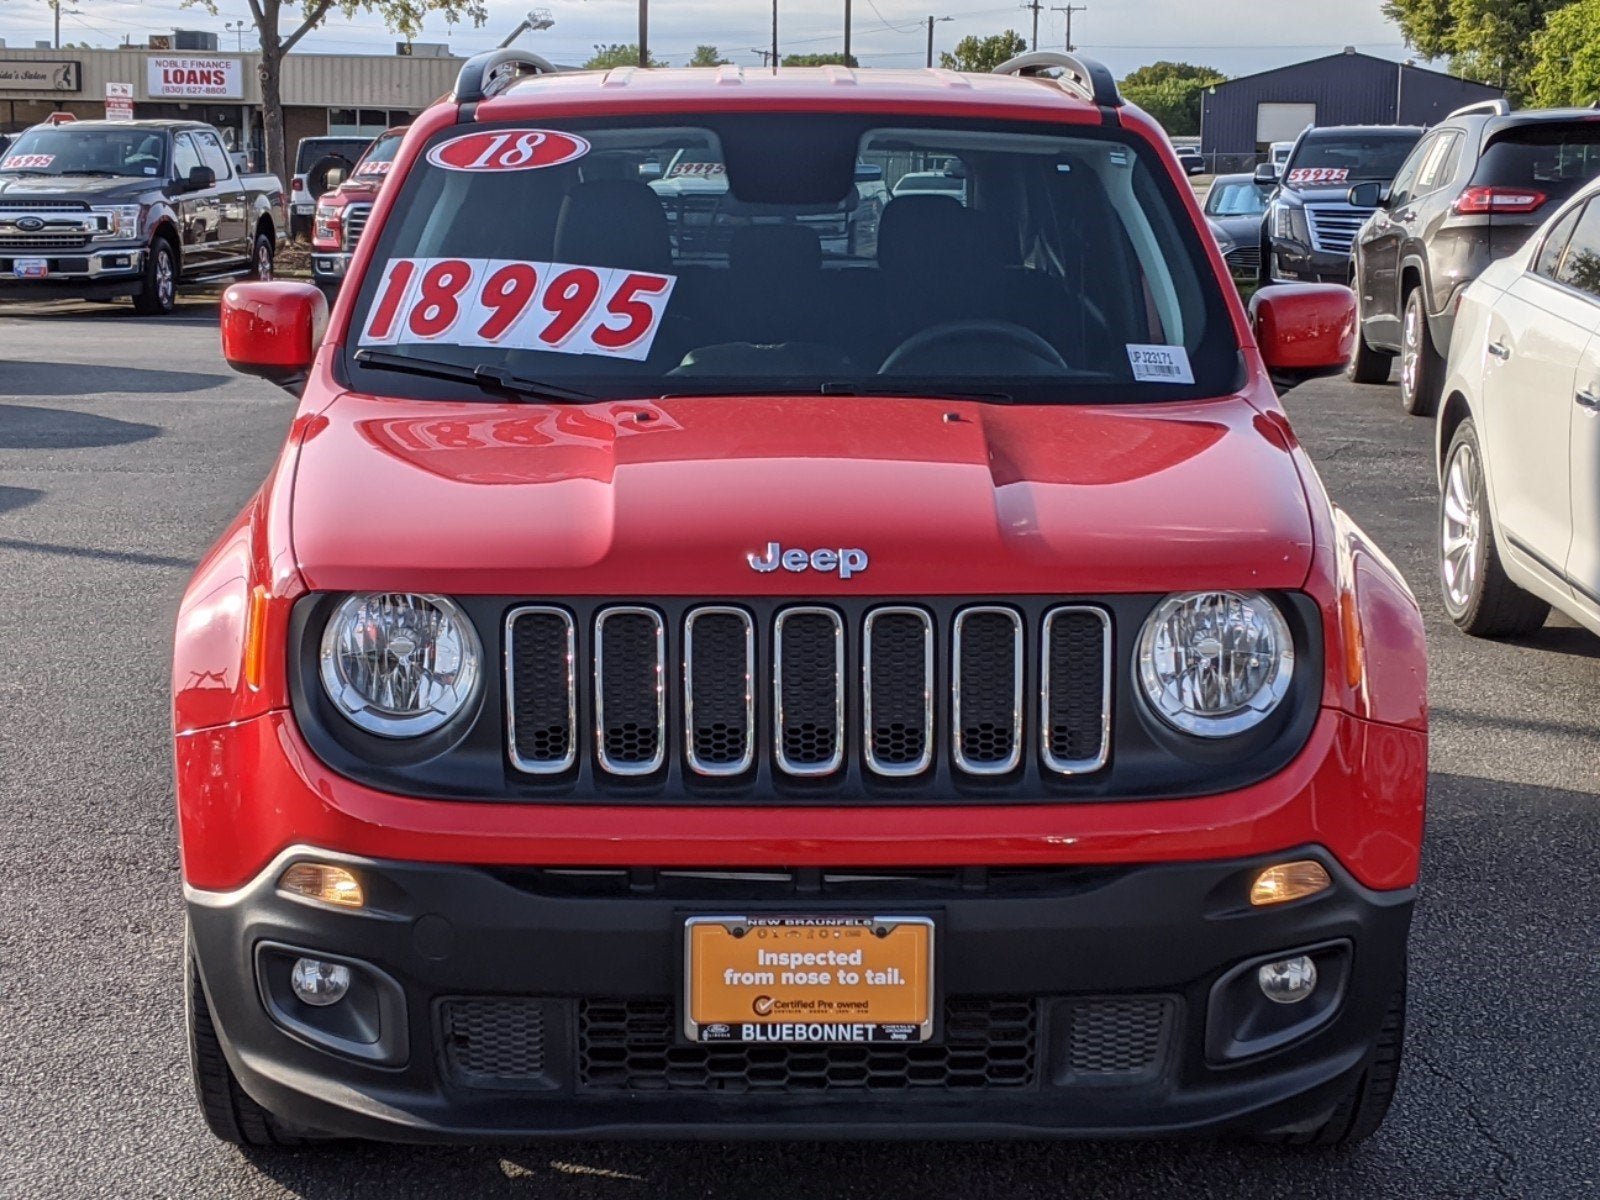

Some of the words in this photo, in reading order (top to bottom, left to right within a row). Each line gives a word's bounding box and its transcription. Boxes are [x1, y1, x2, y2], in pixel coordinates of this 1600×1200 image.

[155, 60, 188, 69] NOBLE
[190, 61, 231, 70] FINANCE
[163, 69, 225, 85] LOANS
[187, 87, 227, 95] 627-8800
[464, 132, 547, 168] 18
[1289, 168, 1348, 180] 59995
[366, 260, 669, 350] 18995
[747, 542, 868, 579] Jeep
[758, 949, 862, 969] Inspected
[724, 968, 774, 985] from
[781, 972, 831, 985] nose
[837, 969, 859, 985] to
[865, 967, 906, 985] tail.
[774, 1000, 815, 1009] Certified
[742, 1024, 877, 1041] BLUEBONNET
